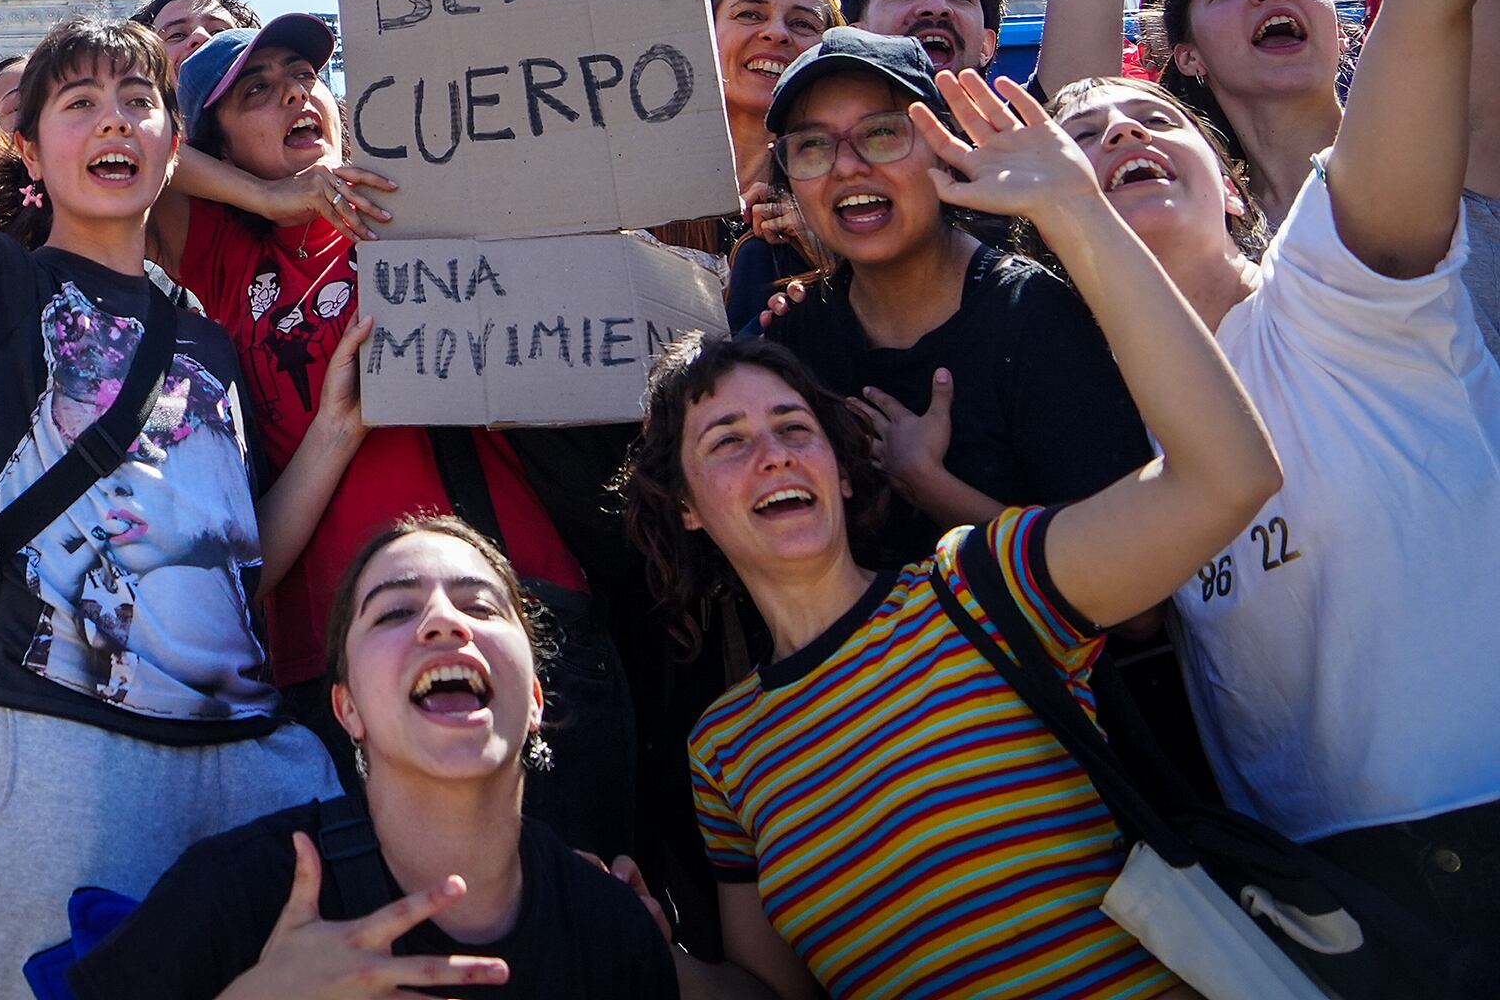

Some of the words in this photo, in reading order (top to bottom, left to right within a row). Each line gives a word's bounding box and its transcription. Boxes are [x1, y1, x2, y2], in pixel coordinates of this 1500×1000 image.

[352, 42, 695, 165] CUERPO
[372, 253, 508, 306] UNA
[1250, 516, 1302, 572] 22
